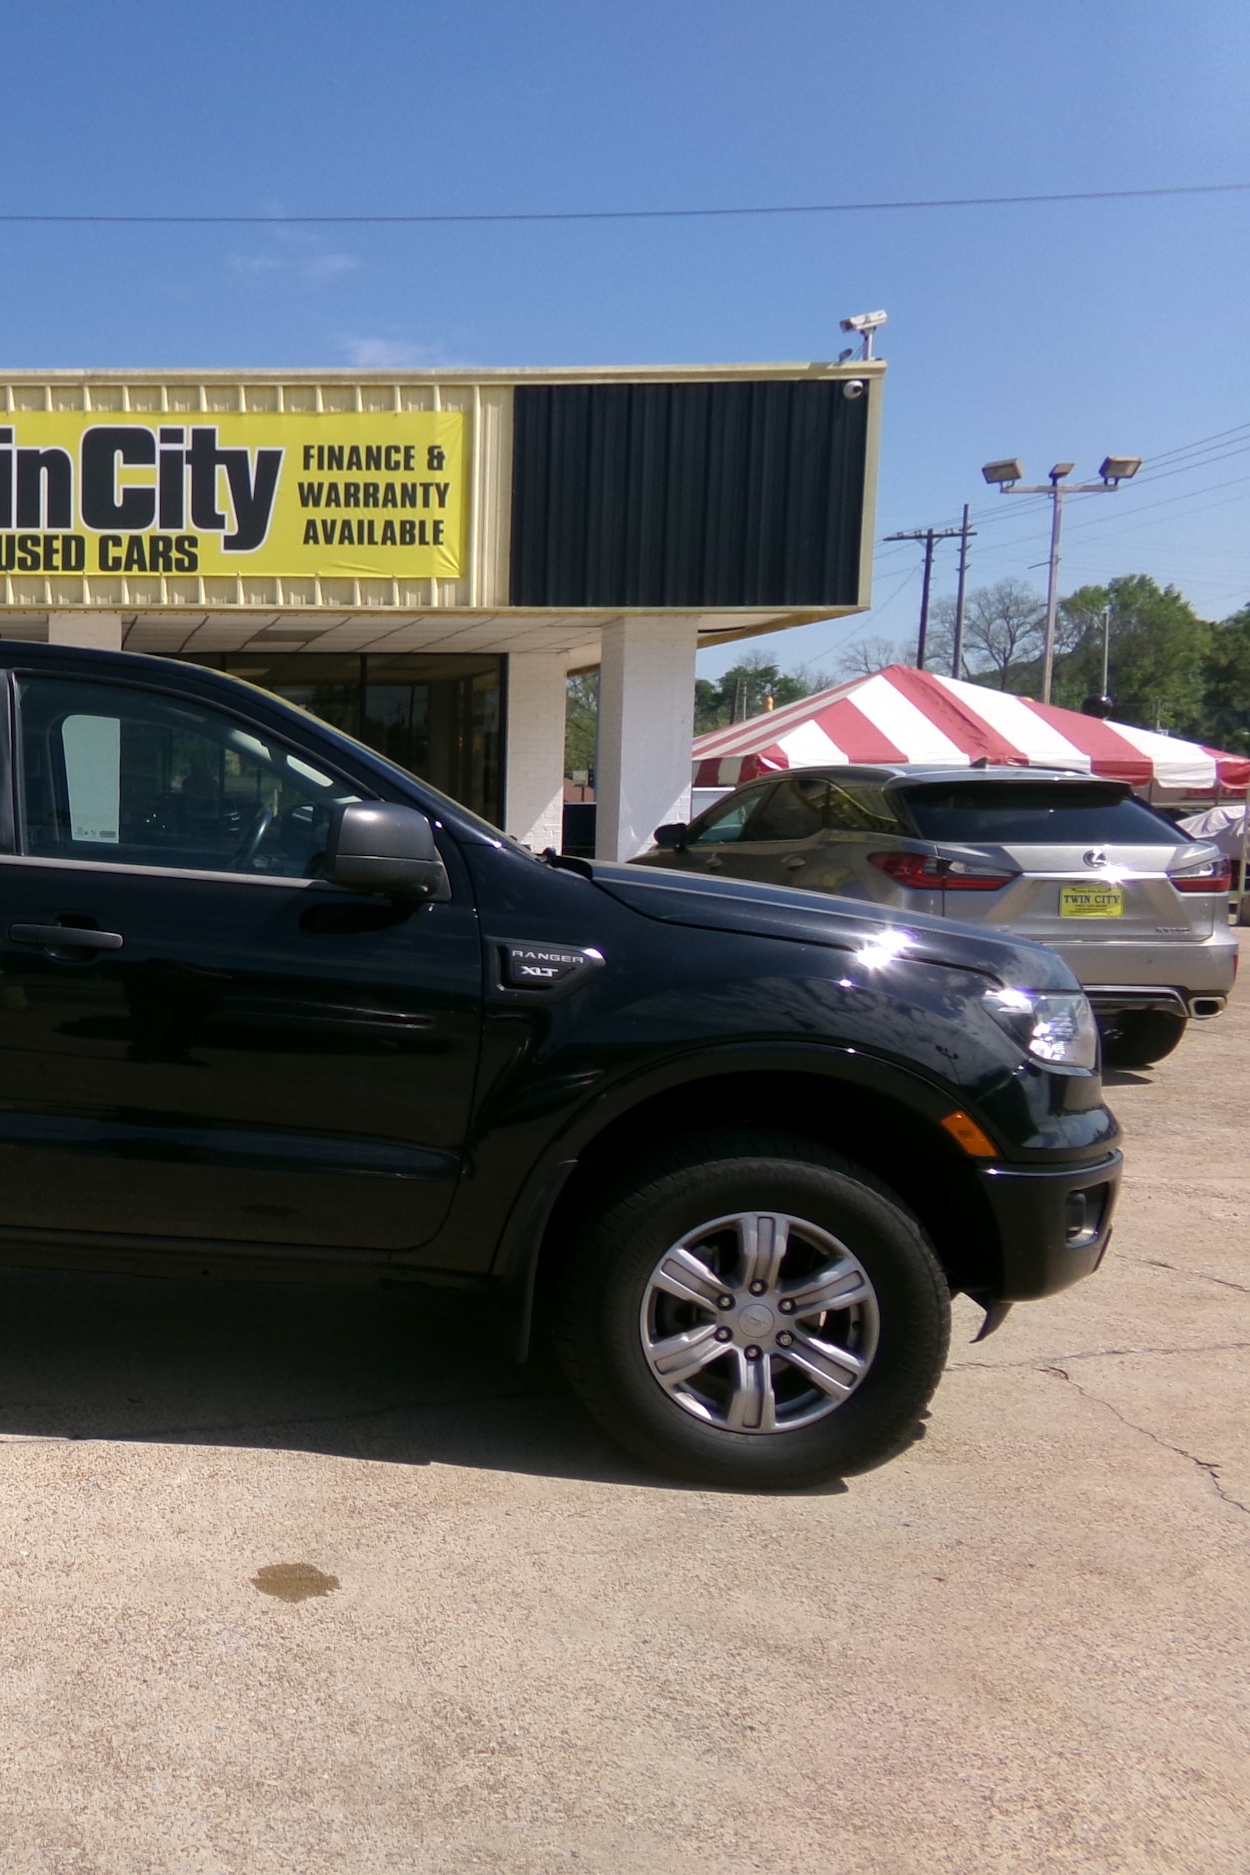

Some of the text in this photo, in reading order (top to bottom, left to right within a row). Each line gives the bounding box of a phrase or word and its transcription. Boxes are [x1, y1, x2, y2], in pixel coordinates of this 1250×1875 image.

[303, 445, 446, 472] FINANCE &
[298, 482, 450, 508] WARRANTY
[303, 519, 444, 546] AVAILABLE
[99, 535, 199, 572] CARS
[1063, 894, 1121, 904] TWIN CITY
[512, 950, 584, 964] RANGER
[520, 965, 559, 977] XLT
